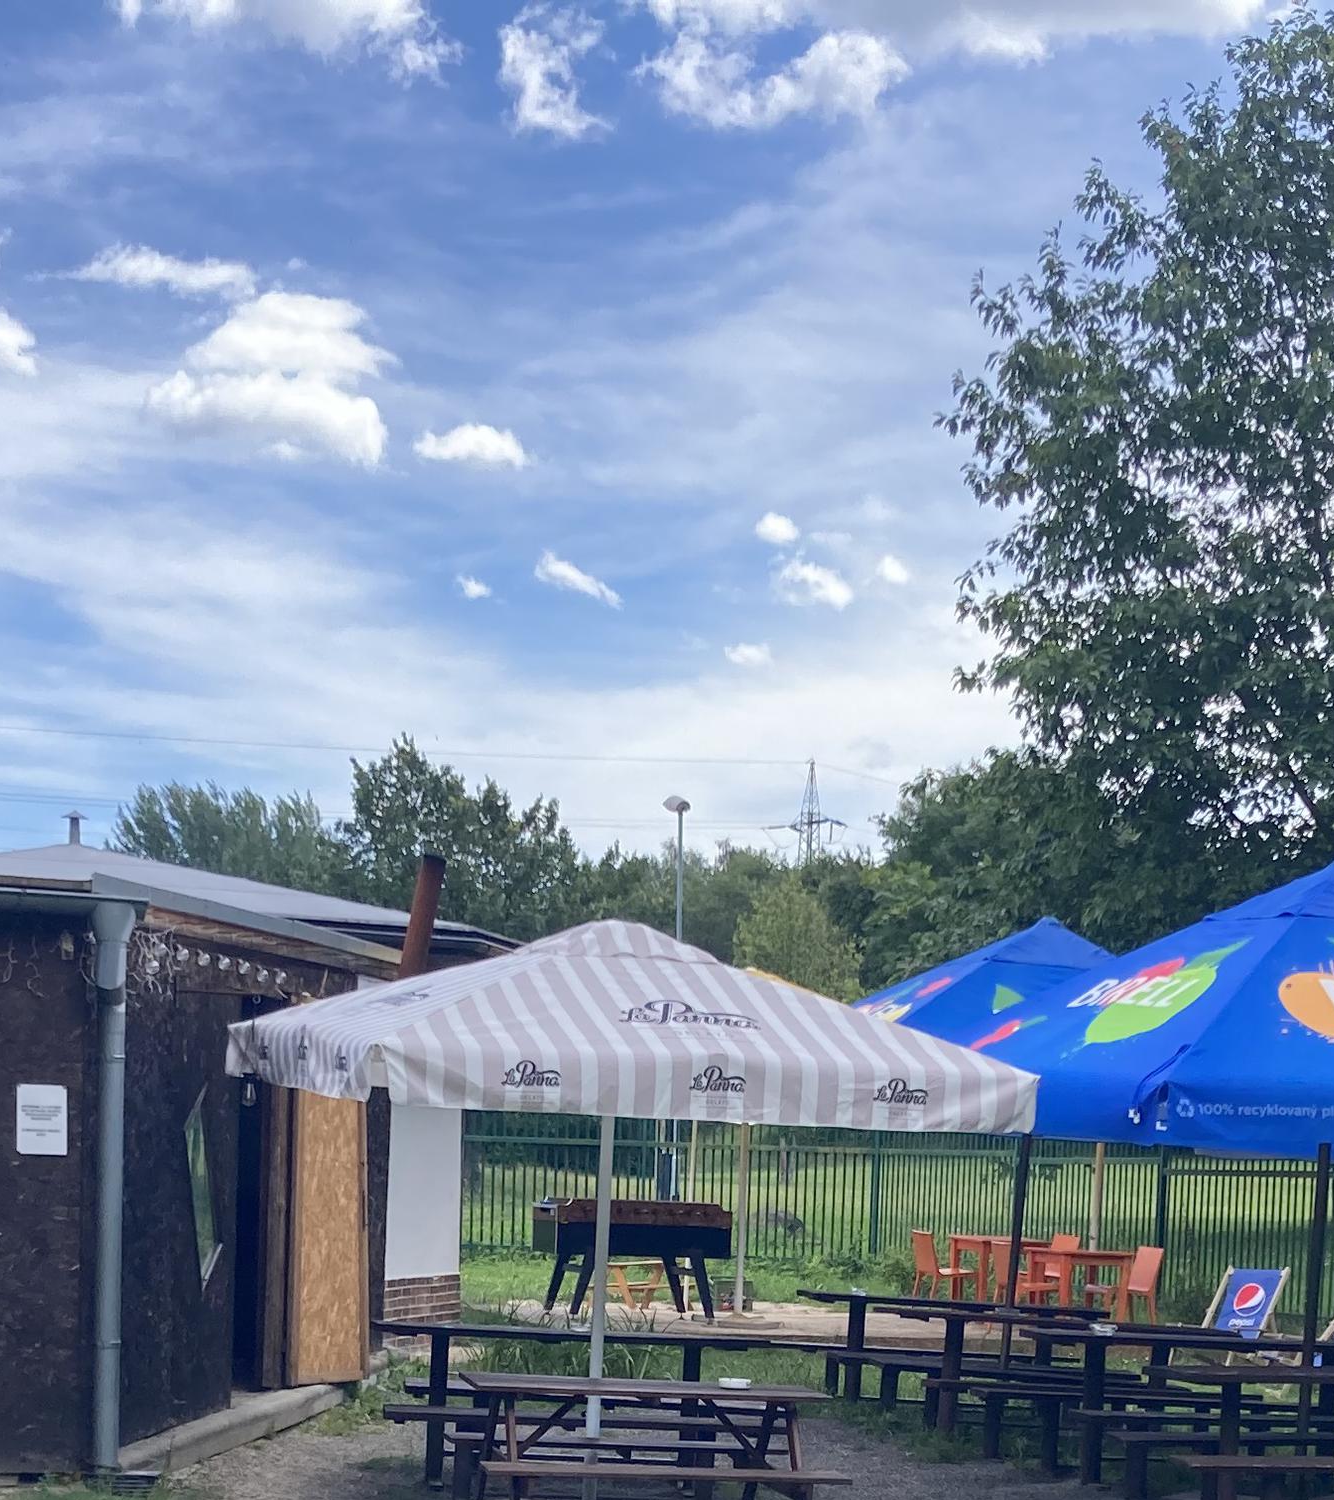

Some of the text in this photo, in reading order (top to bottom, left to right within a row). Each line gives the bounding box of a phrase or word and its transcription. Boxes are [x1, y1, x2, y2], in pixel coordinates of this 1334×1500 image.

[1067, 978, 1200, 1009] BIRELL
[644, 999, 762, 1031] Panna
[501, 1060, 562, 1089] La Panna
[689, 1065, 747, 1094] La Panna
[873, 1078, 929, 1106] La Panna
[1197, 1104, 1234, 1116] 100%
[1238, 1103, 1317, 1119] recyklovaný
